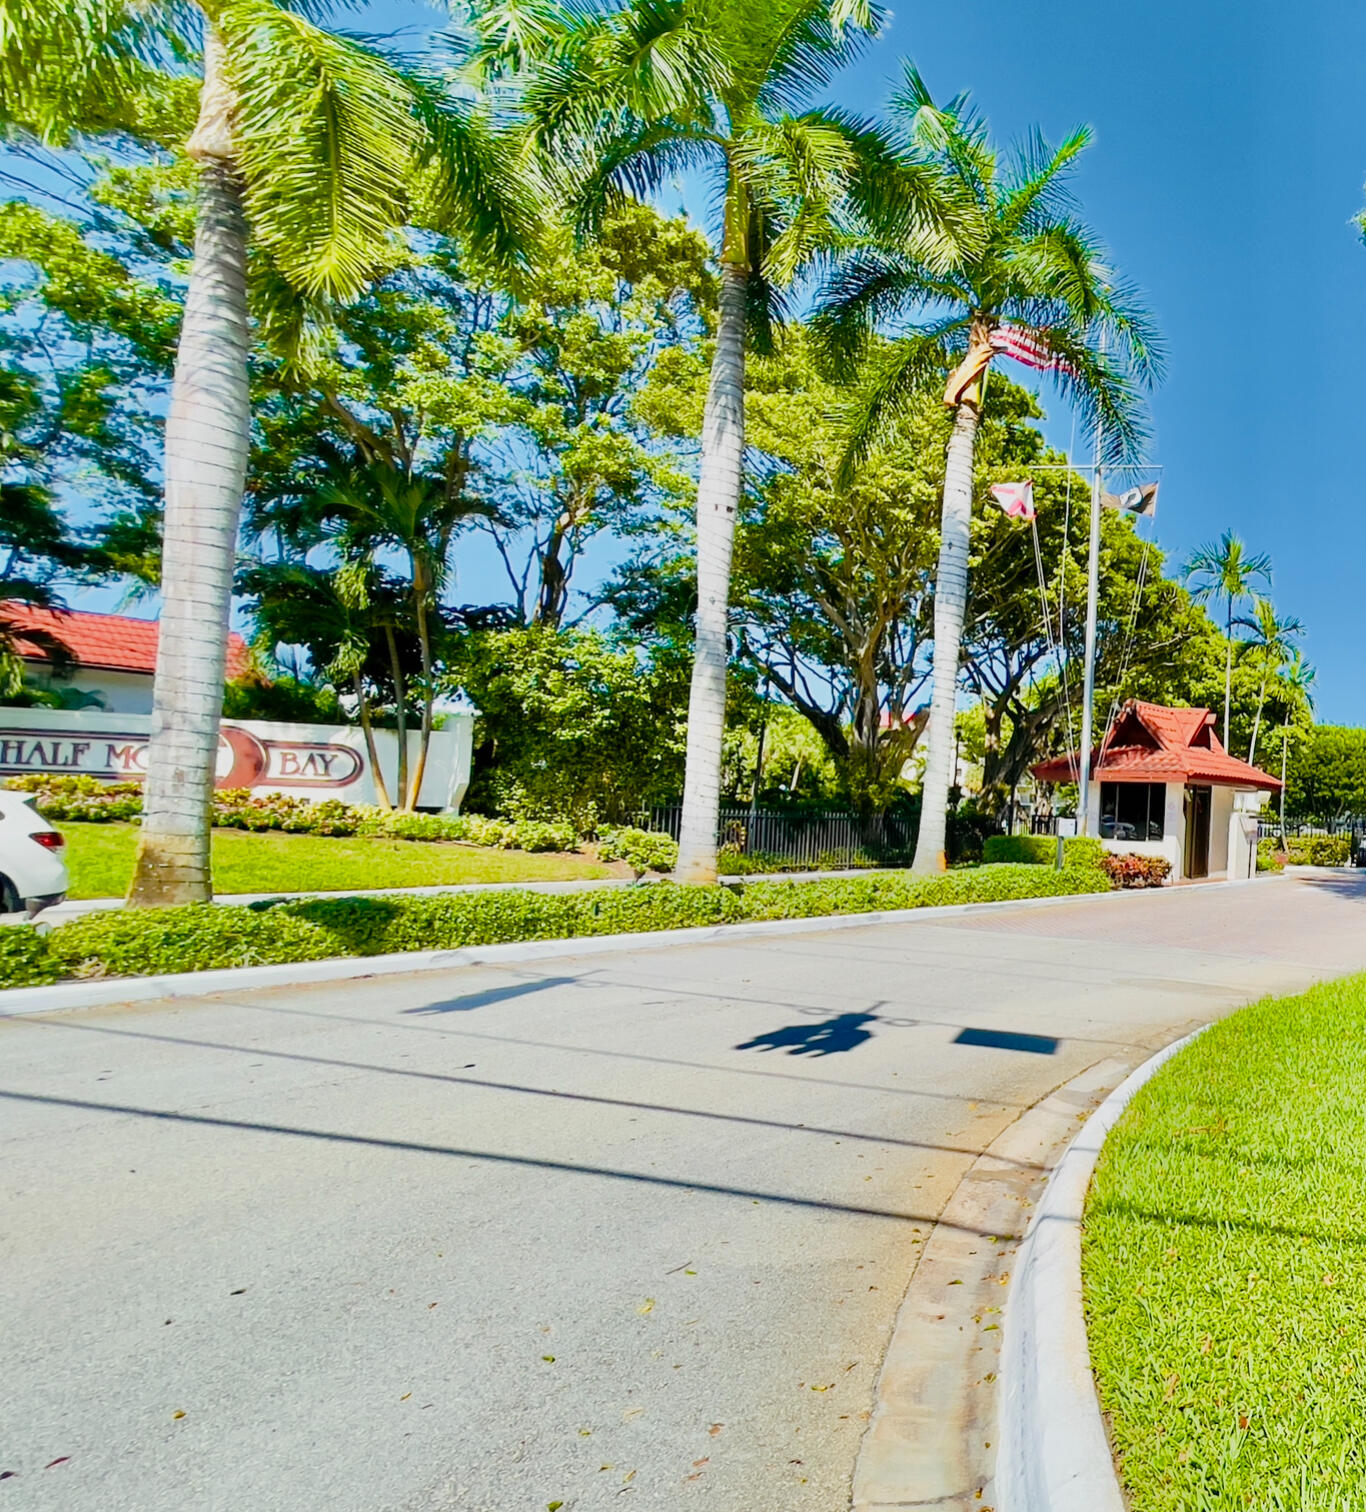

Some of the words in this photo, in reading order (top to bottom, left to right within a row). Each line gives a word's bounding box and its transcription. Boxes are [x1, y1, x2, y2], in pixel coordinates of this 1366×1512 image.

[1, 740, 90, 766] HALF
[104, 743, 149, 770] MO
[280, 752, 339, 777] BAY
